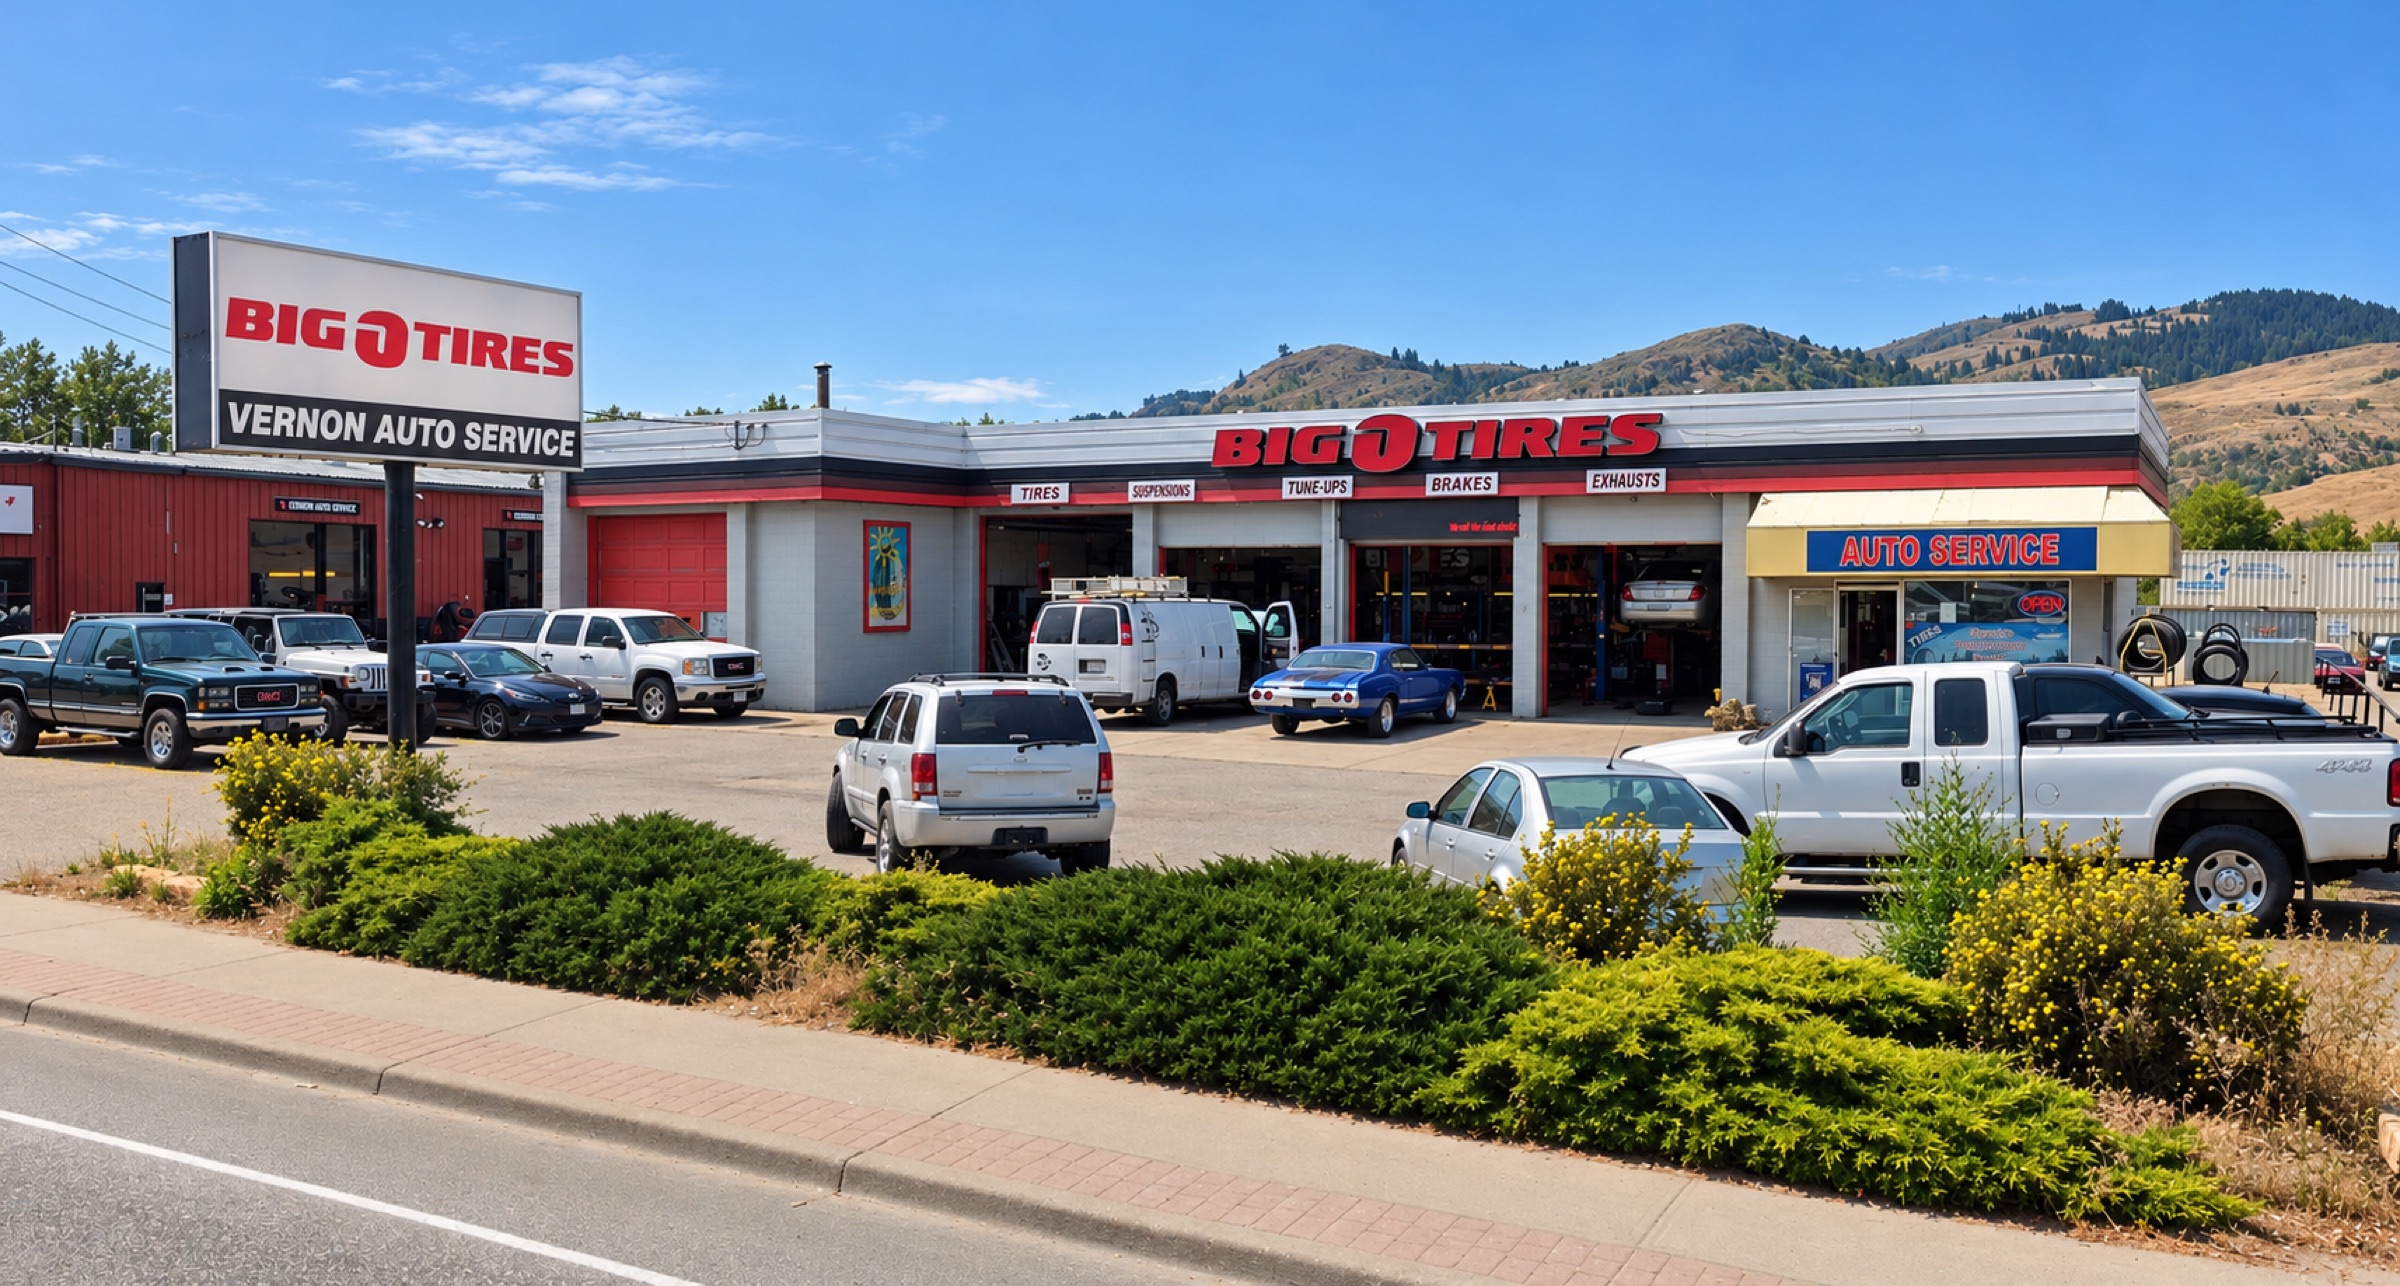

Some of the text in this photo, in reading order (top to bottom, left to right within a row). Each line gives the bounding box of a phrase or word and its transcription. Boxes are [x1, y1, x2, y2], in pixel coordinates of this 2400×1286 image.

[225, 297, 347, 351] BIG
[413, 321, 575, 378] TIRES
[228, 401, 577, 458] VERNON AUTO SERVICE
[1211, 426, 1344, 468] BIG
[1424, 412, 1664, 462] TIRES
[1288, 480, 1348, 495] TUNE-UPS
[1431, 475, 1493, 492] BRAKES
[1592, 472, 1661, 489] EXHAUSTS
[1020, 486, 1060, 500] TIRES
[1132, 484, 1191, 498] SUSPENSIONS
[1839, 533, 2060, 567] AUTO SERVICE
[2020, 596, 2063, 613] OPEN
